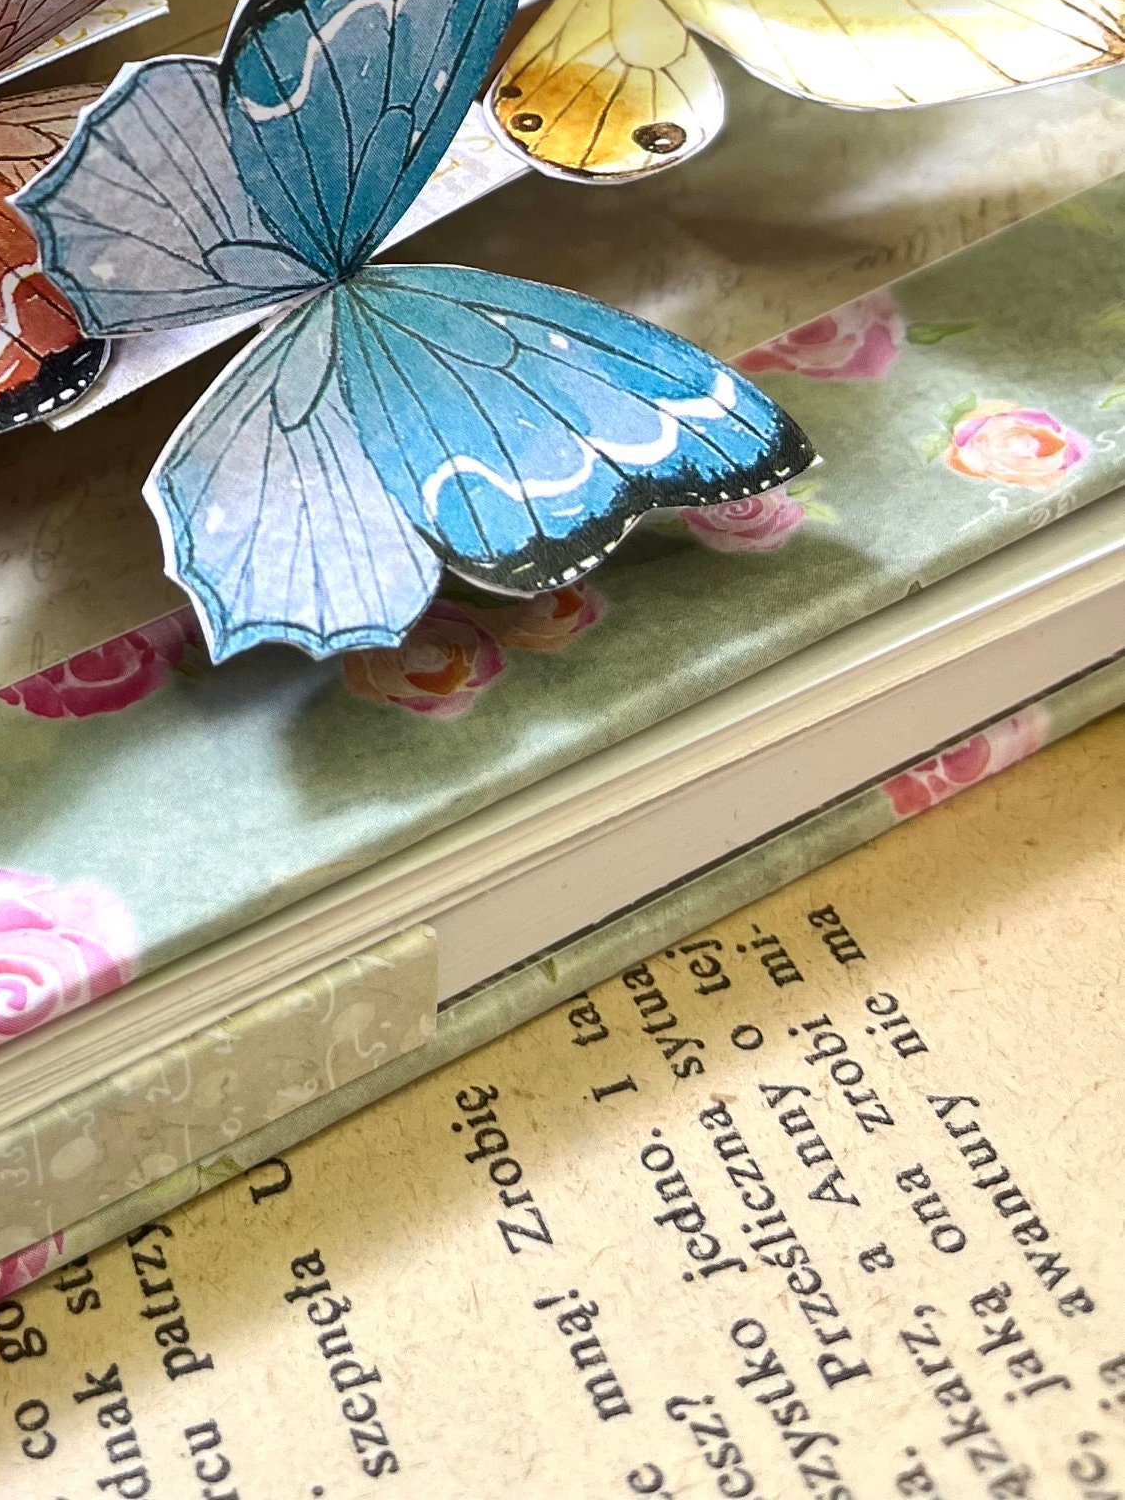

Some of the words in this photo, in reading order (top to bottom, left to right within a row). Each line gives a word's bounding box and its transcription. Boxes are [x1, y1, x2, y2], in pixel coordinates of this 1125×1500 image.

[665, 937, 733, 996] tej
[736, 922, 805, 989] mi-
[807, 903, 867, 965] ma
[730, 1023, 764, 1051] o
[787, 1012, 895, 1134] zrobi
[864, 991, 929, 1060] nie
[590, 1073, 639, 1103] I
[450, 1083, 554, 1255] Zrobię
[758, 1081, 861, 1207] Anny
[639, 1126, 748, 1283] jedno.
[698, 1100, 872, 1390] Prześliczna
[858, 1241, 895, 1274] a
[895, 1162, 967, 1254] ona
[925, 1093, 1097, 1318] awantury
[283, 1247, 400, 1479] szepnęła
[533, 1288, 633, 1422] mną!
[968, 1280, 1073, 1404] jaką
[14, 1398, 57, 1460] co
